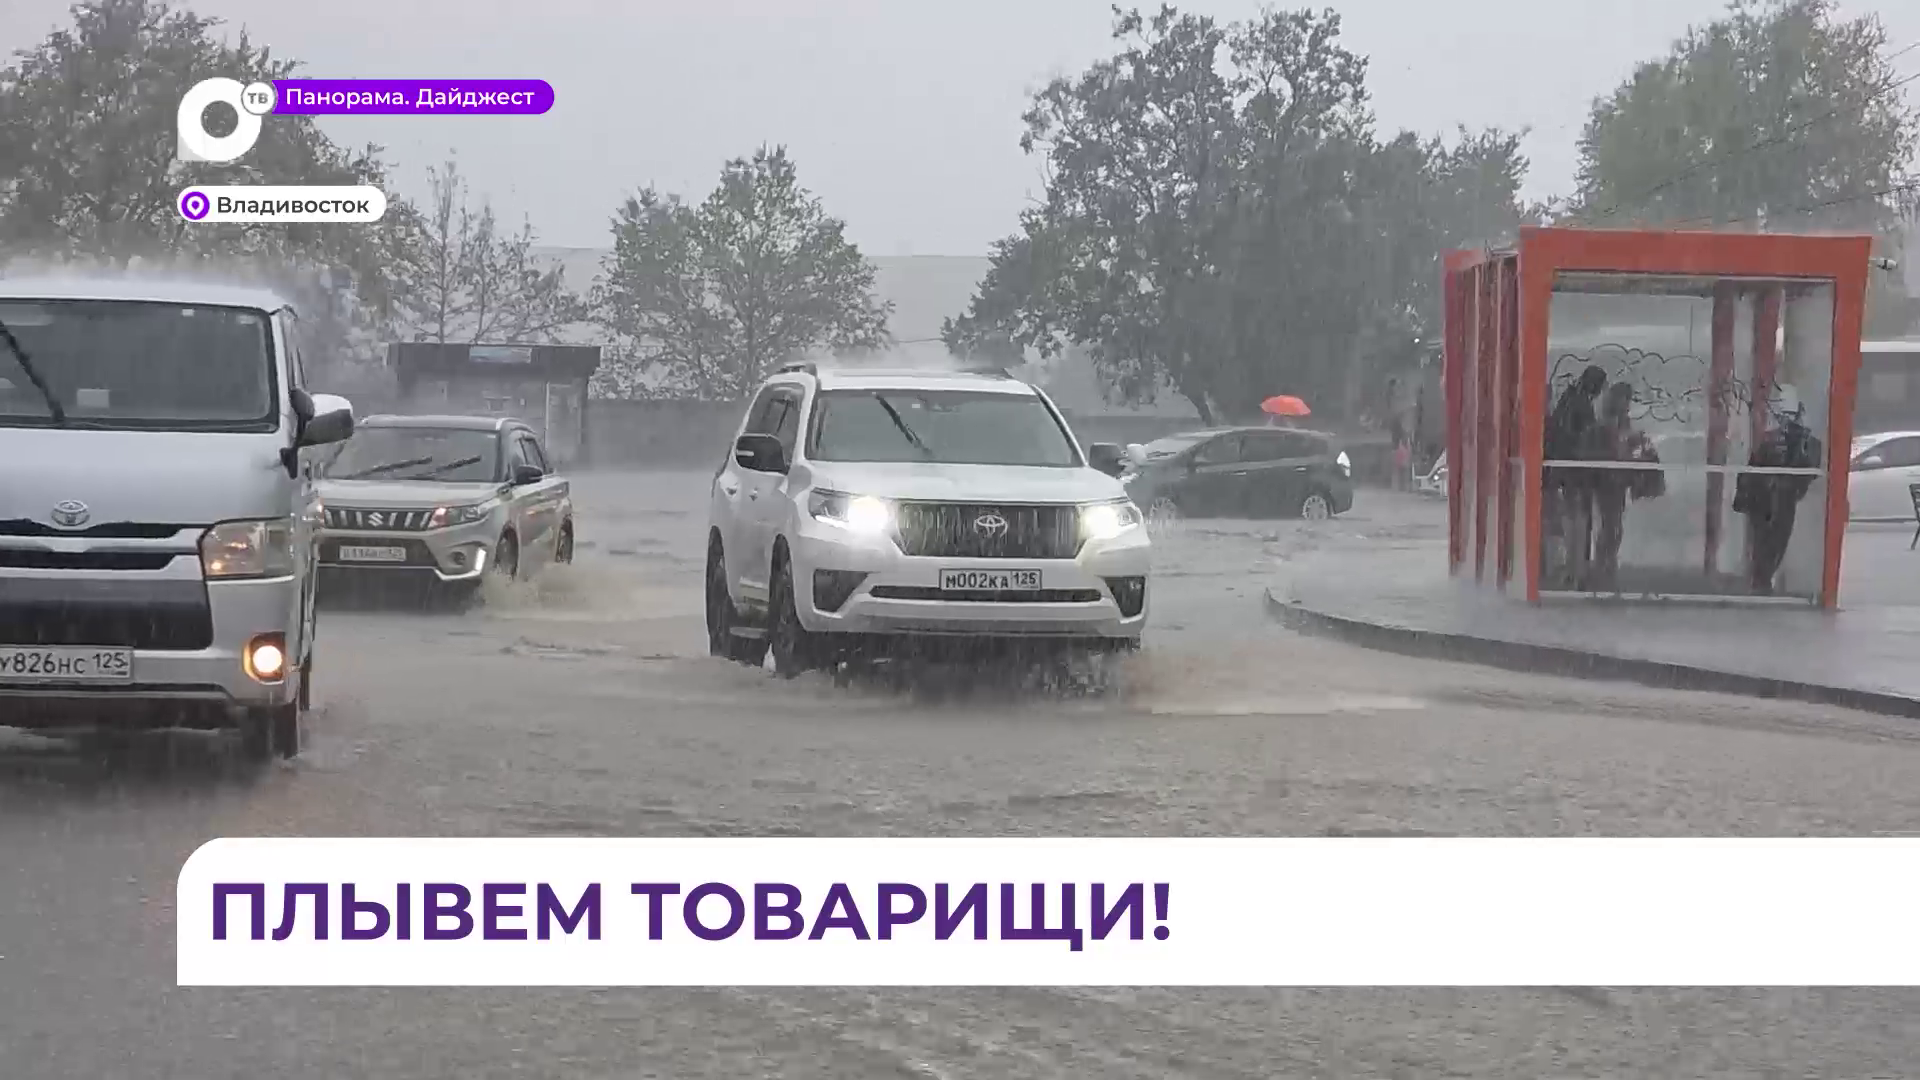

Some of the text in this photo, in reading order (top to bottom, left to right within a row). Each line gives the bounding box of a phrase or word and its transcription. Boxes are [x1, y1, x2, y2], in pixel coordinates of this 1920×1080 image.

[945, 572, 1038, 588] М002КА 125
[92, 652, 127, 669] 125
